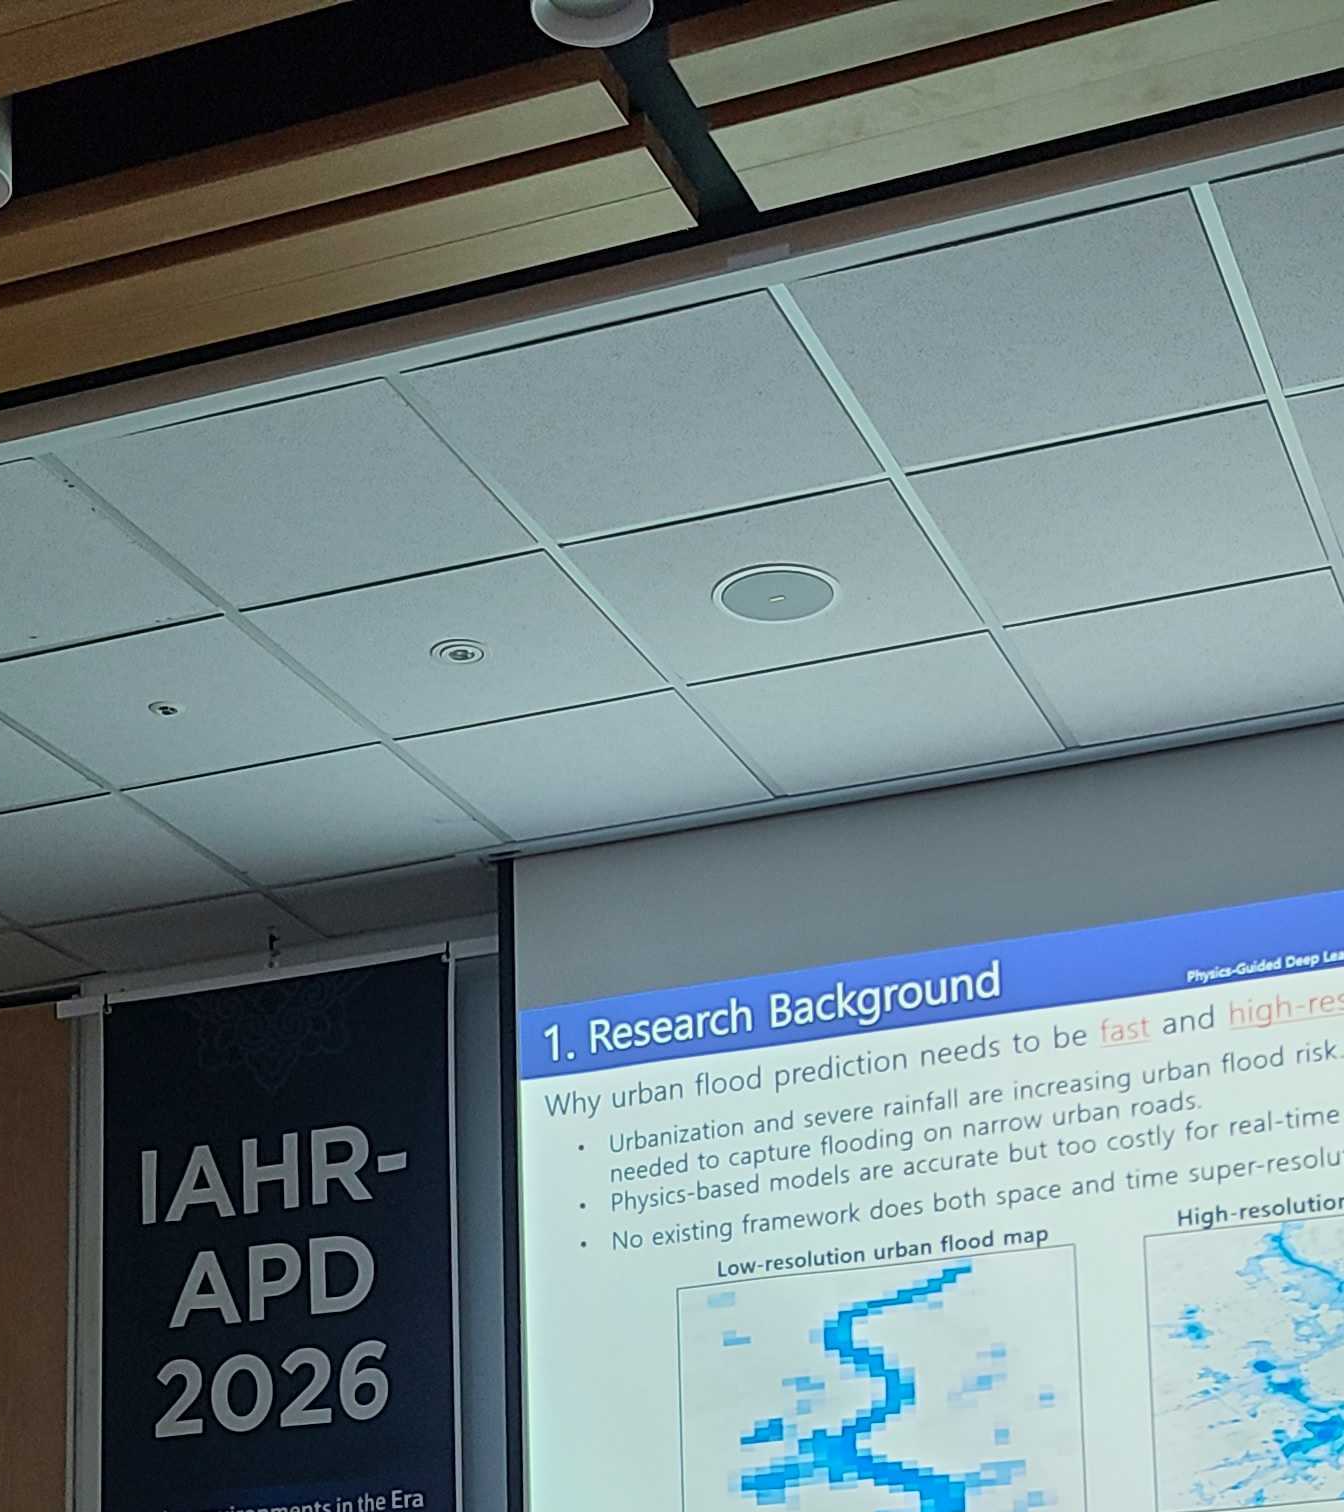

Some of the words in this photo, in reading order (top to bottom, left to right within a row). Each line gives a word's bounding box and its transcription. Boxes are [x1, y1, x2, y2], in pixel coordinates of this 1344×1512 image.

[544, 1025, 576, 1063] 1.
[590, 1000, 754, 1053] Research
[770, 960, 1001, 1028] Background
[1186, 957, 1282, 983] Physics-Guided
[1285, 954, 1320, 975] Deep
[544, 1090, 601, 1120] Why
[611, 1080, 684, 1109] urban
[695, 1064, 762, 1097] flood
[774, 1050, 908, 1094] prediction
[920, 1034, 1001, 1067] needs
[1012, 1033, 1040, 1054] to
[1053, 1024, 1088, 1049] be
[1100, 1018, 1149, 1043] fast
[1162, 1003, 1215, 1036] and
[609, 1120, 745, 1153] Urbanization
[753, 1109, 794, 1134] and
[803, 1105, 874, 1129] severe
[883, 1087, 958, 1117] rainfall
[968, 1088, 1003, 1107] are
[1013, 1070, 1131, 1101] increasing
[1142, 1061, 1211, 1085] urban
[1221, 1045, 1284, 1074] flood
[1296, 1039, 1344, 1065] risk.
[141, 1125, 407, 1225] IAHR-
[612, 1230, 644, 1251] No
[652, 1219, 733, 1246] existing
[741, 1202, 861, 1235] framework
[869, 1198, 924, 1220] does
[933, 1187, 986, 1213] both
[996, 1183, 1062, 1209] space
[1071, 1170, 1115, 1196] and
[1125, 1170, 1179, 1190] time
[168, 1235, 375, 1328] APD
[717, 1248, 866, 1279] Low-resolution
[873, 1240, 933, 1264] urban
[940, 1232, 993, 1255] flood
[1003, 1228, 1049, 1251] map
[155, 1340, 389, 1438] 2026
[391, 1489, 424, 1509] Era
